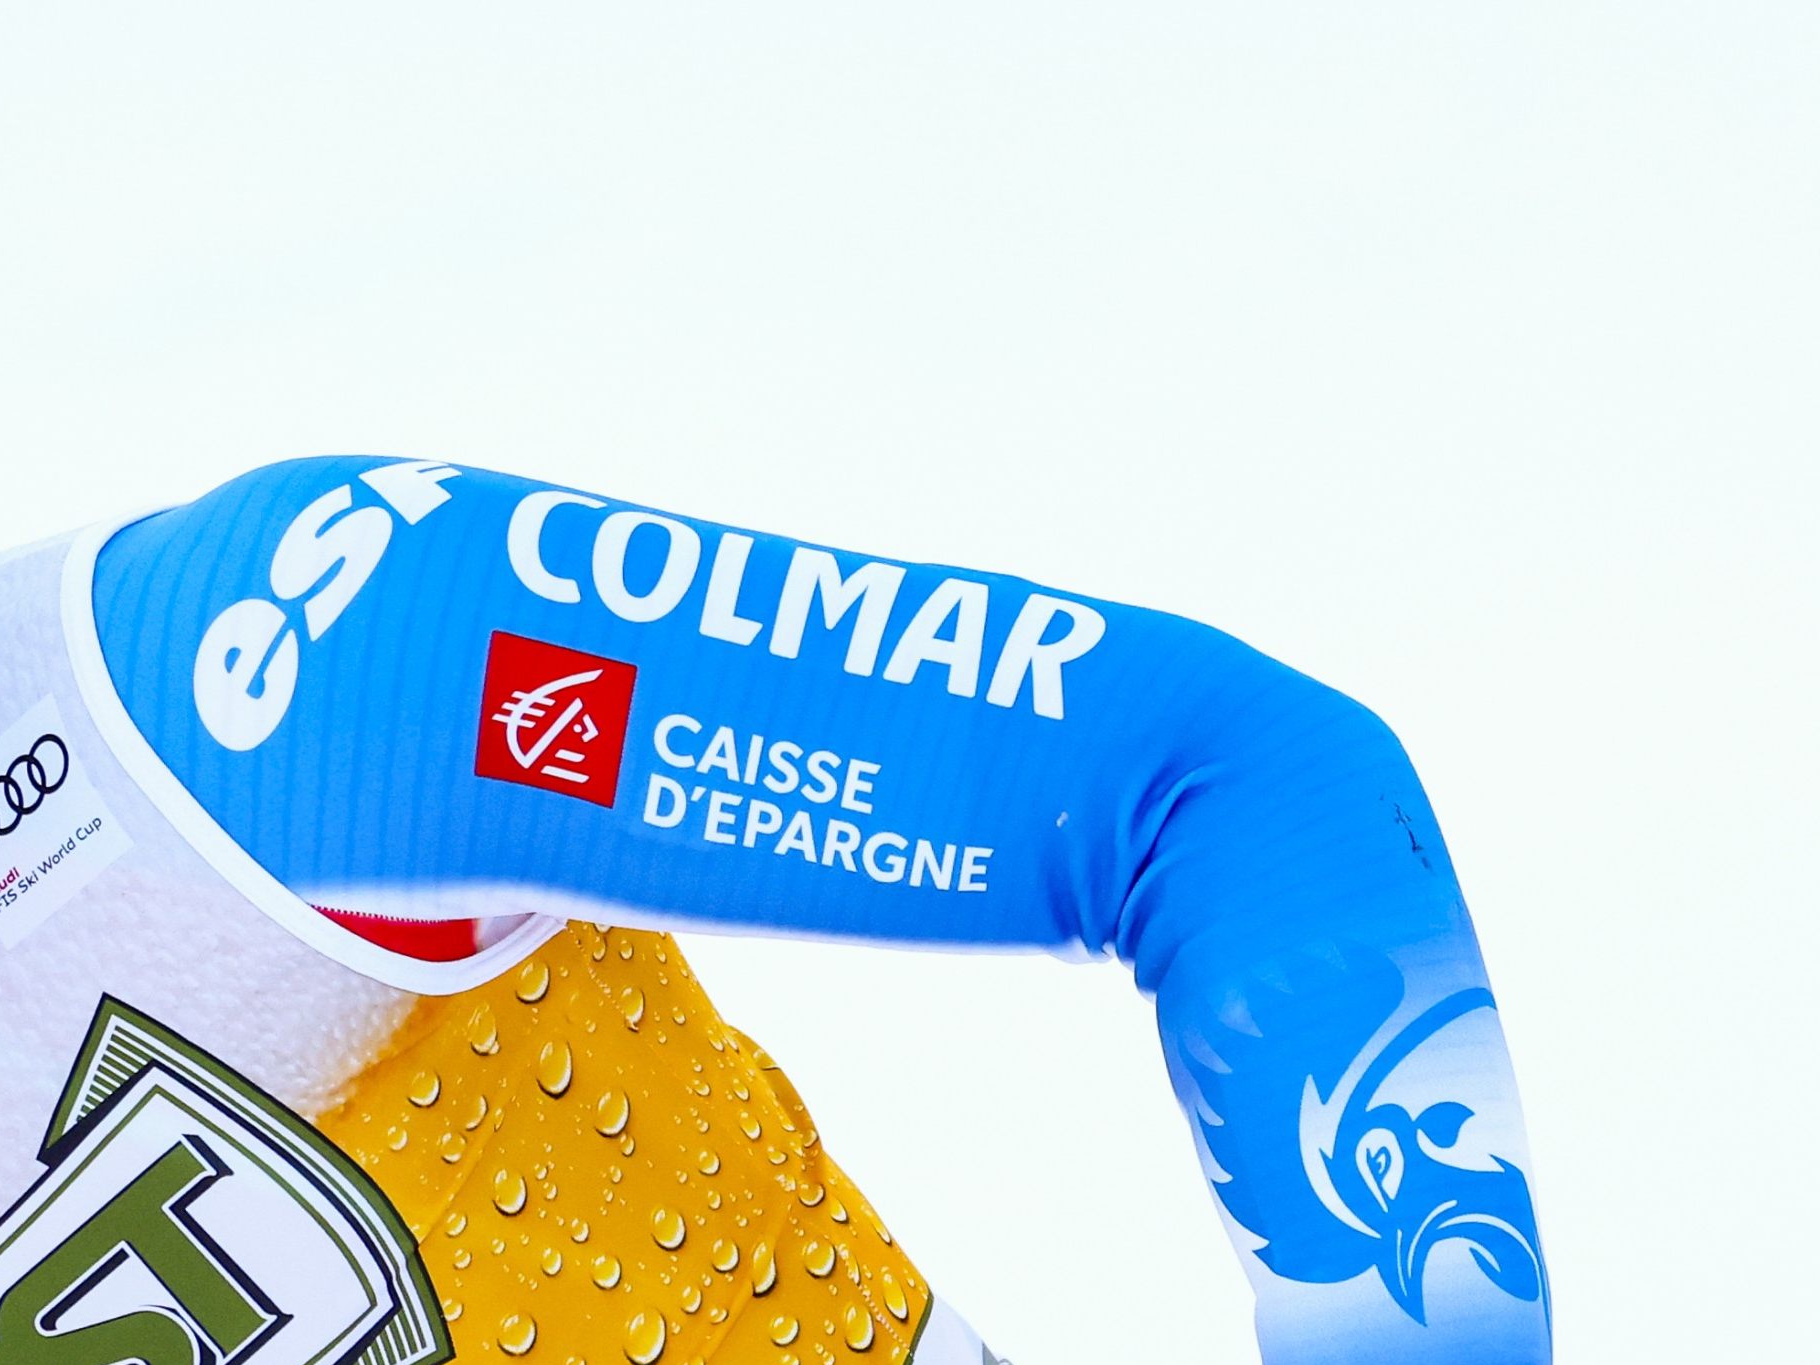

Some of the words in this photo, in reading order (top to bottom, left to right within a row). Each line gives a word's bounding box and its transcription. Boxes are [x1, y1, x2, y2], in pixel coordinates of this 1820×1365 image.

[506, 489, 1107, 721] COLMAR
[652, 713, 882, 816] CAISSE
[17, 870, 40, 894] Ski
[37, 836, 77, 875] World
[75, 816, 103, 842] Cup
